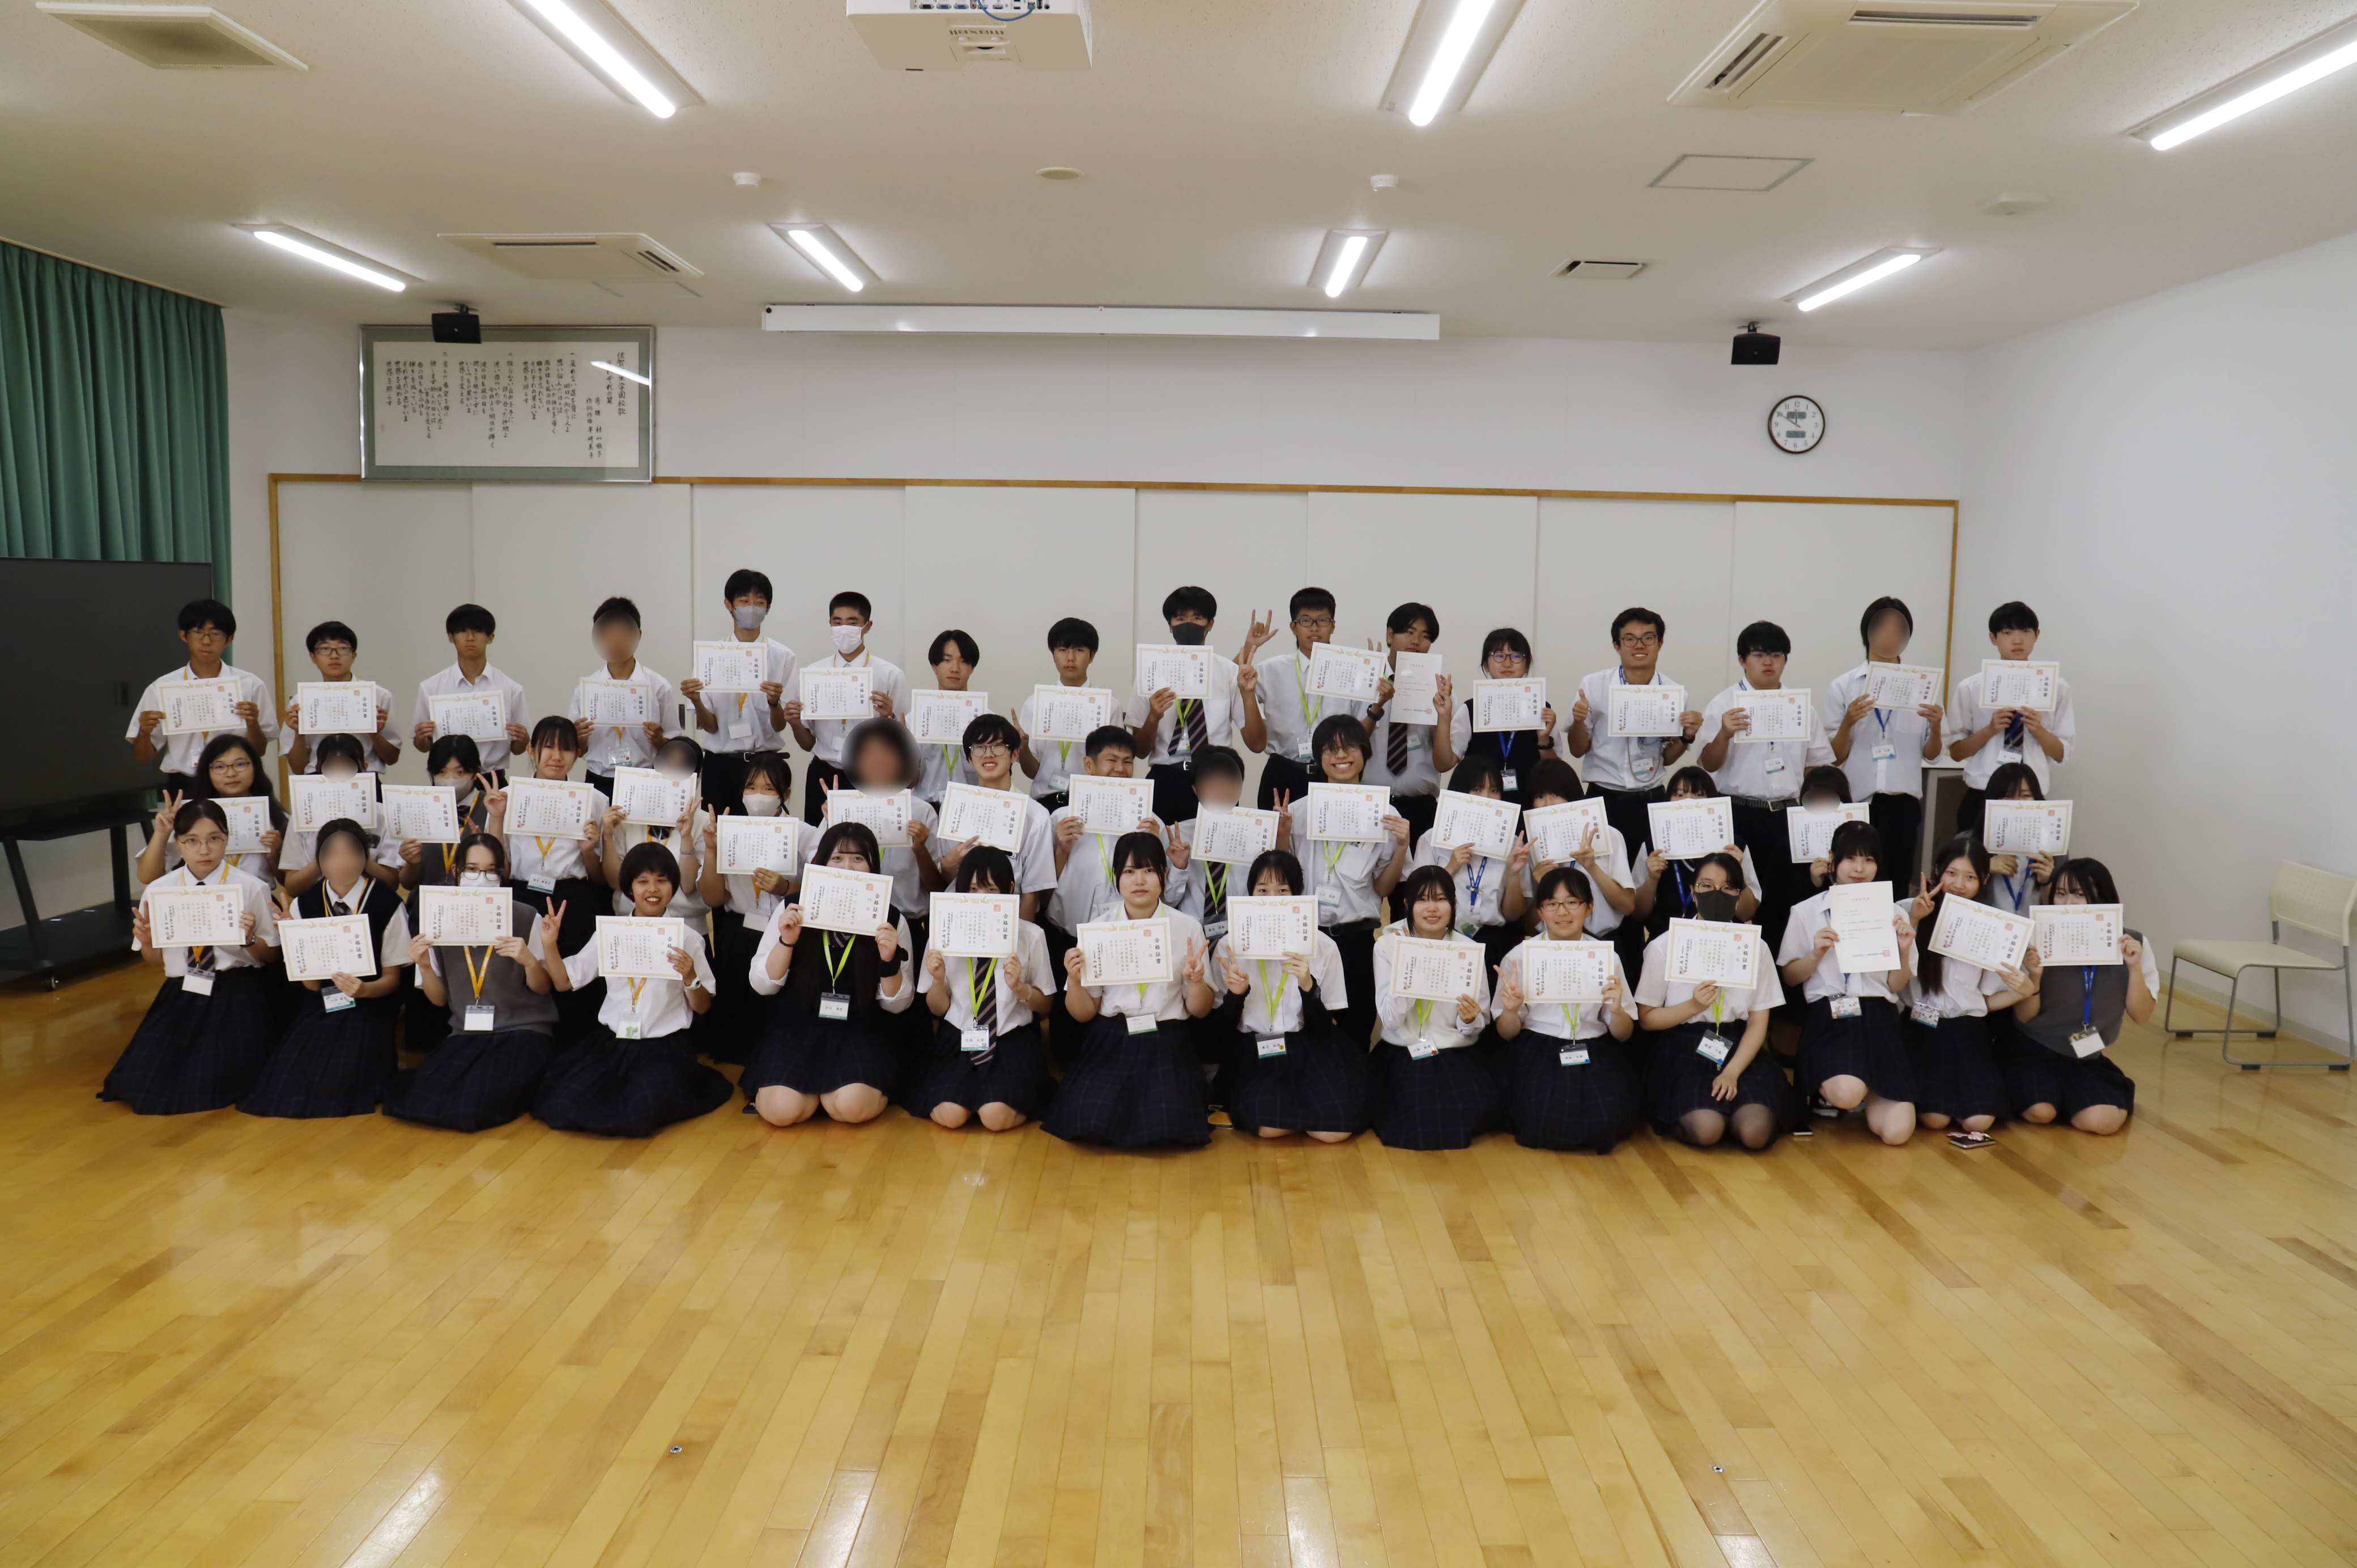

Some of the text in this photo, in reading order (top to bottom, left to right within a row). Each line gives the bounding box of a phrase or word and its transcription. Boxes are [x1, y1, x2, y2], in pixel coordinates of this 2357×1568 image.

[616, 351, 626, 416] 佐賀生学園校歌
[1499, 820, 1508, 844] 合格証書
[2006, 934, 2019, 959] 合格証書
